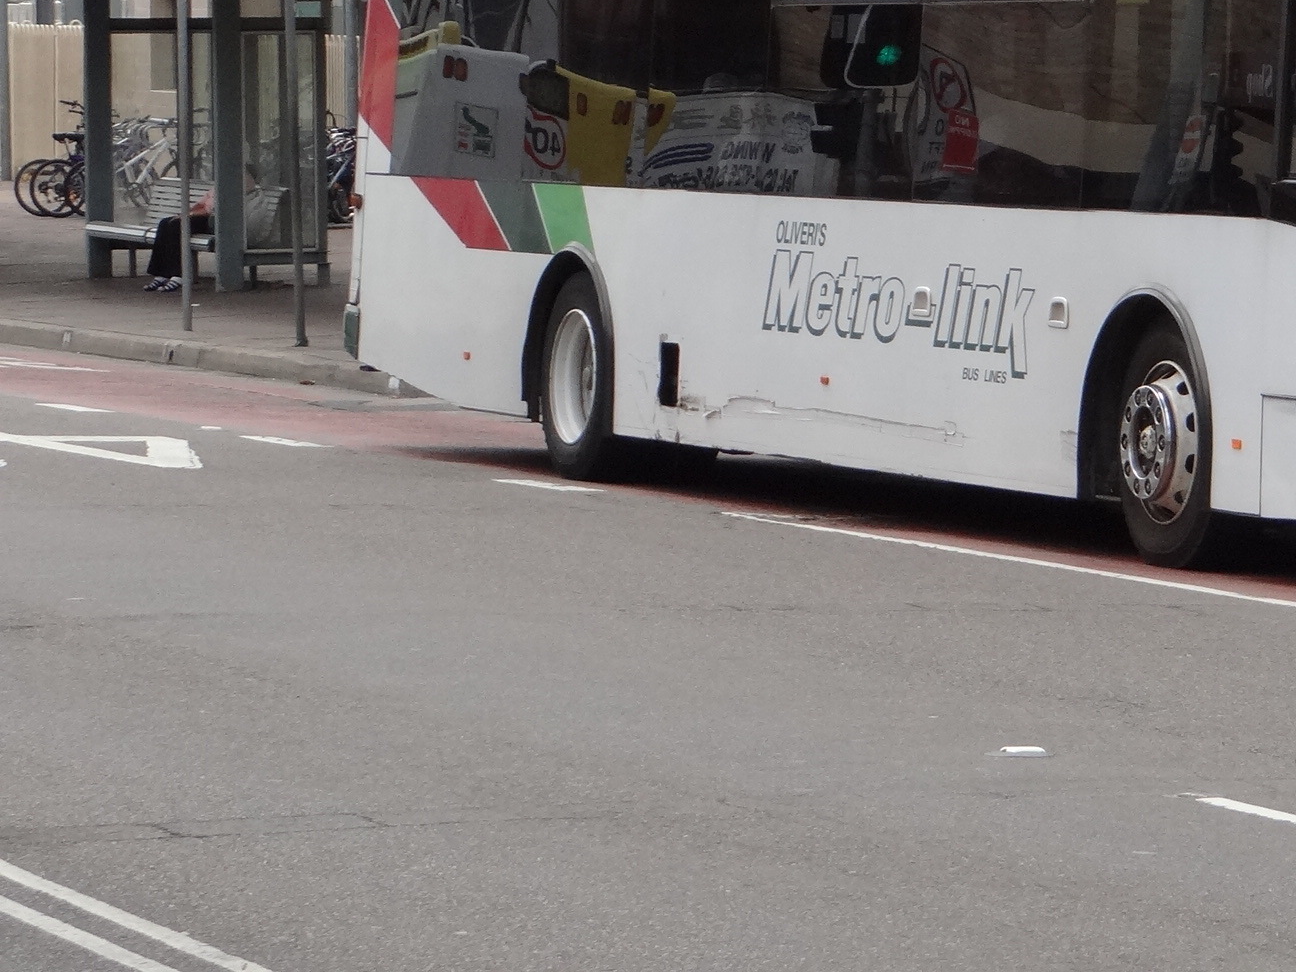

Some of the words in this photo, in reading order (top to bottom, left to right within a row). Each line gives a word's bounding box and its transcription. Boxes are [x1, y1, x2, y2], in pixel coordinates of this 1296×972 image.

[776, 219, 828, 247] OLIVERI'S
[961, 367, 979, 382] BUS
[984, 368, 1007, 384] LINES
